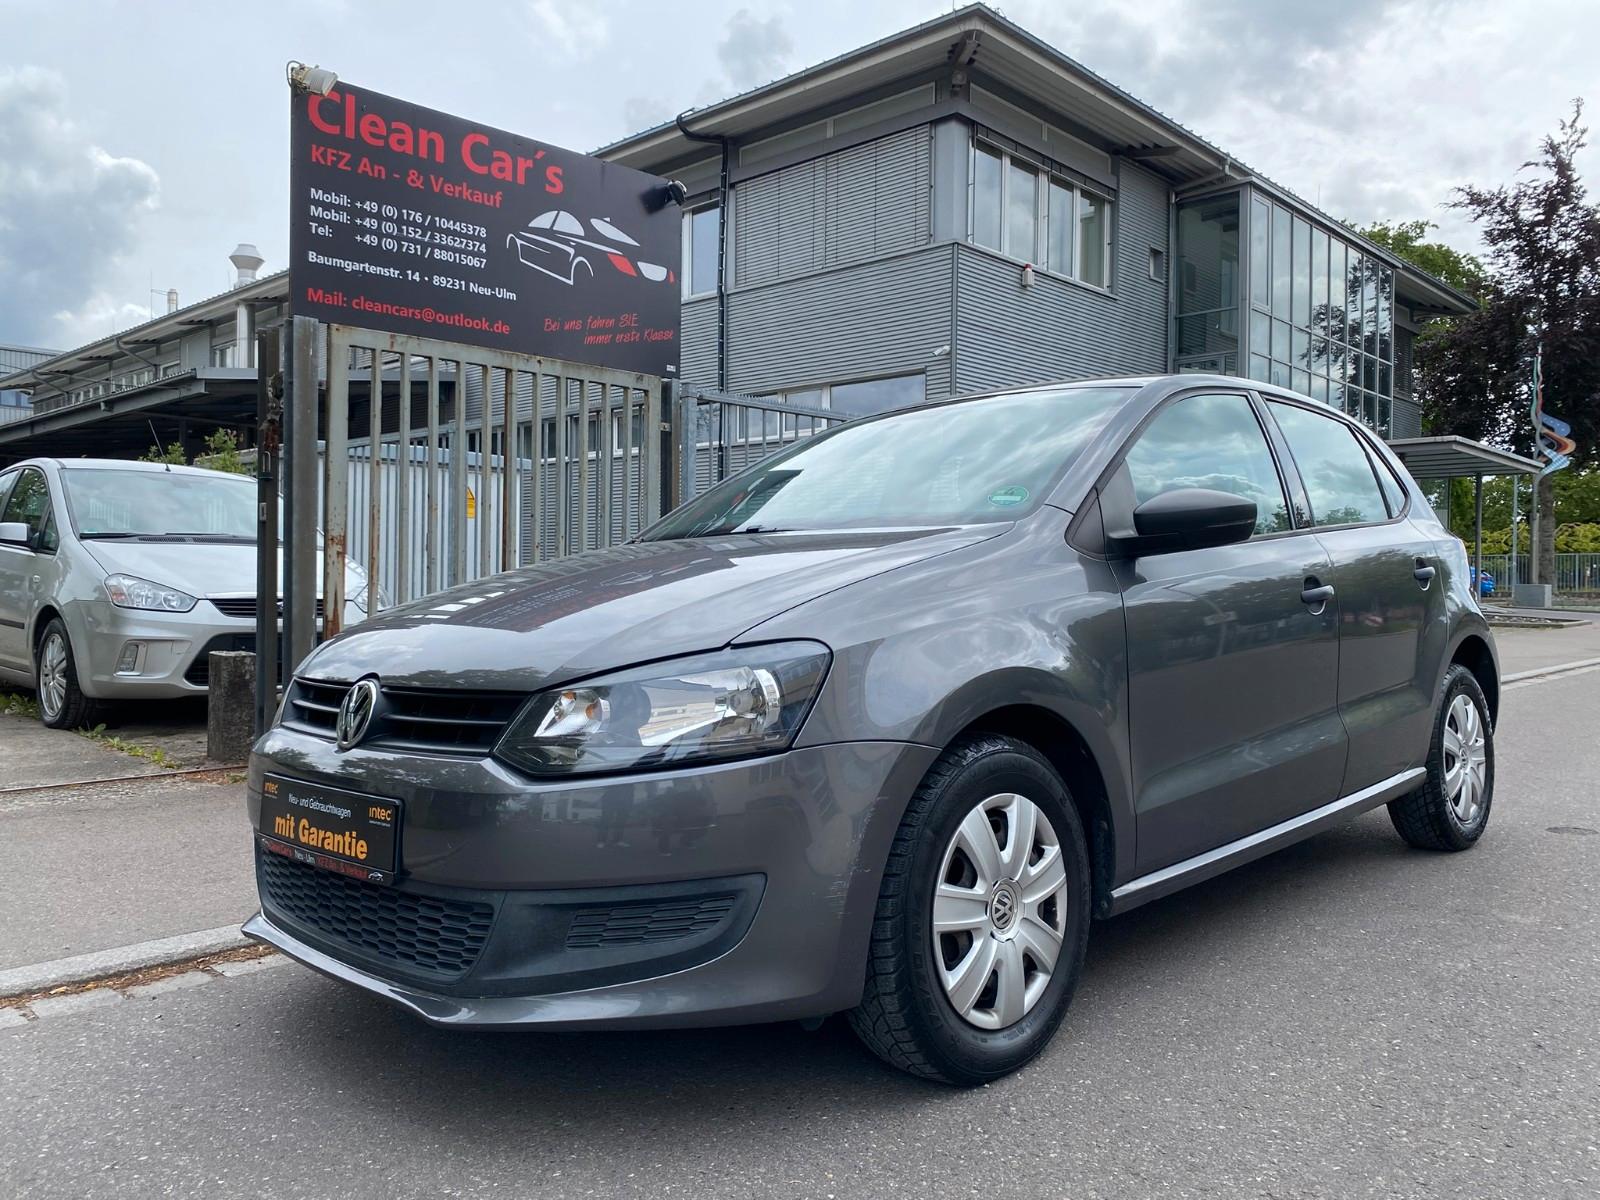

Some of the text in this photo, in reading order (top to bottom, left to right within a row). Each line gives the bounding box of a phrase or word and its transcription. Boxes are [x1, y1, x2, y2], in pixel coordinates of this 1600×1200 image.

[307, 91, 445, 163] Clean
[311, 144, 352, 171] KFZ
[358, 157, 386, 179] An
[406, 169, 424, 190] &
[430, 174, 503, 208] Verkauf
[310, 187, 351, 207] Mobil:
[355, 201, 379, 213] +49
[382, 204, 398, 220] (0)
[401, 209, 423, 223] 176
[434, 216, 487, 238] 10445378
[310, 205, 351, 224] Mobil:
[355, 217, 379, 230] +49
[381, 221, 397, 236] (0)
[401, 225, 422, 239] 152
[433, 232, 487, 254] 33627374
[309, 222, 333, 237] Tel:
[355, 234, 379, 246] +49
[381, 237, 398, 252] (0)
[401, 241, 421, 255] 731
[433, 248, 487, 269] 88015067
[308, 250, 403, 279] Baumgartenstr.
[406, 269, 420, 282] 14
[432, 275, 466, 291] 89231
[469, 282, 517, 300] Neu-Ulm
[307, 287, 510, 334] Mail: cleancars@outlook.de
[544, 313, 640, 332] Bei uns fahren SIE
[584, 328, 674, 345] immer erste Klasse
[274, 813, 295, 839] mit
[298, 818, 368, 860] Garantie
[368, 807, 393, 821] intec
